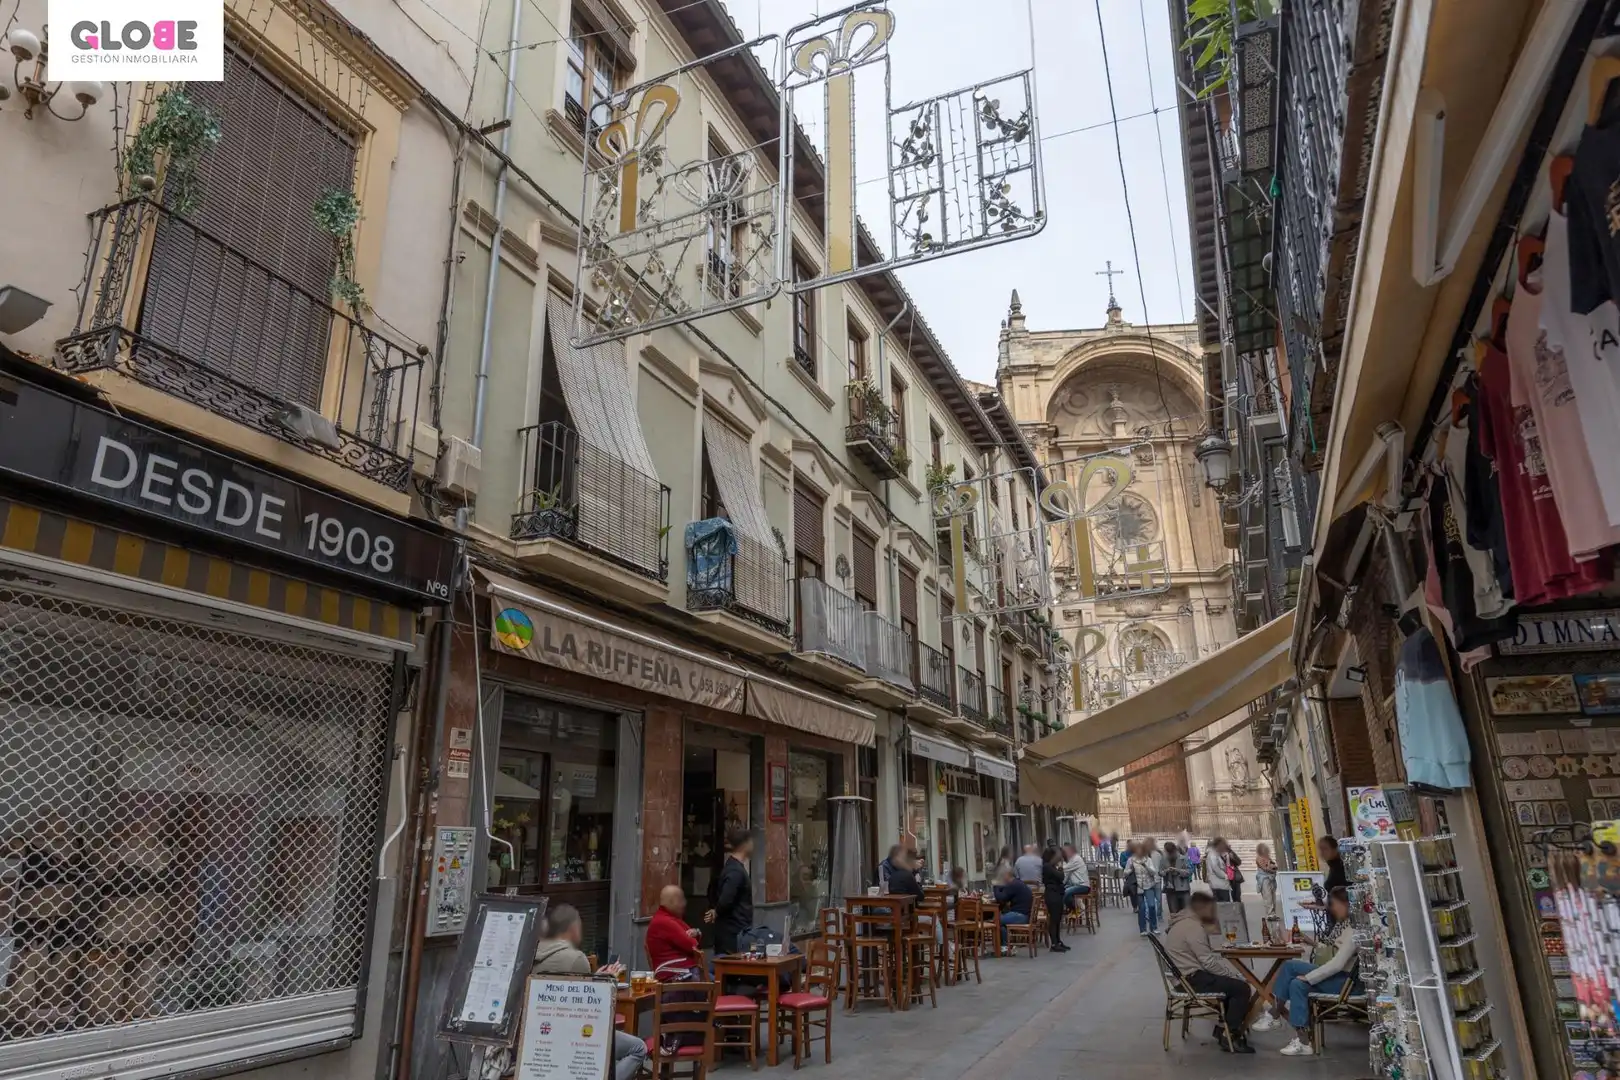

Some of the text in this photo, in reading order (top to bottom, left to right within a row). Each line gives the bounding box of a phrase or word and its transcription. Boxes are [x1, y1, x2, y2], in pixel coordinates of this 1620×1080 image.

[91, 437, 394, 573] DESDE 1908
[543, 626, 578, 660] LA
[587, 640, 682, 689] RIFFEÑA
